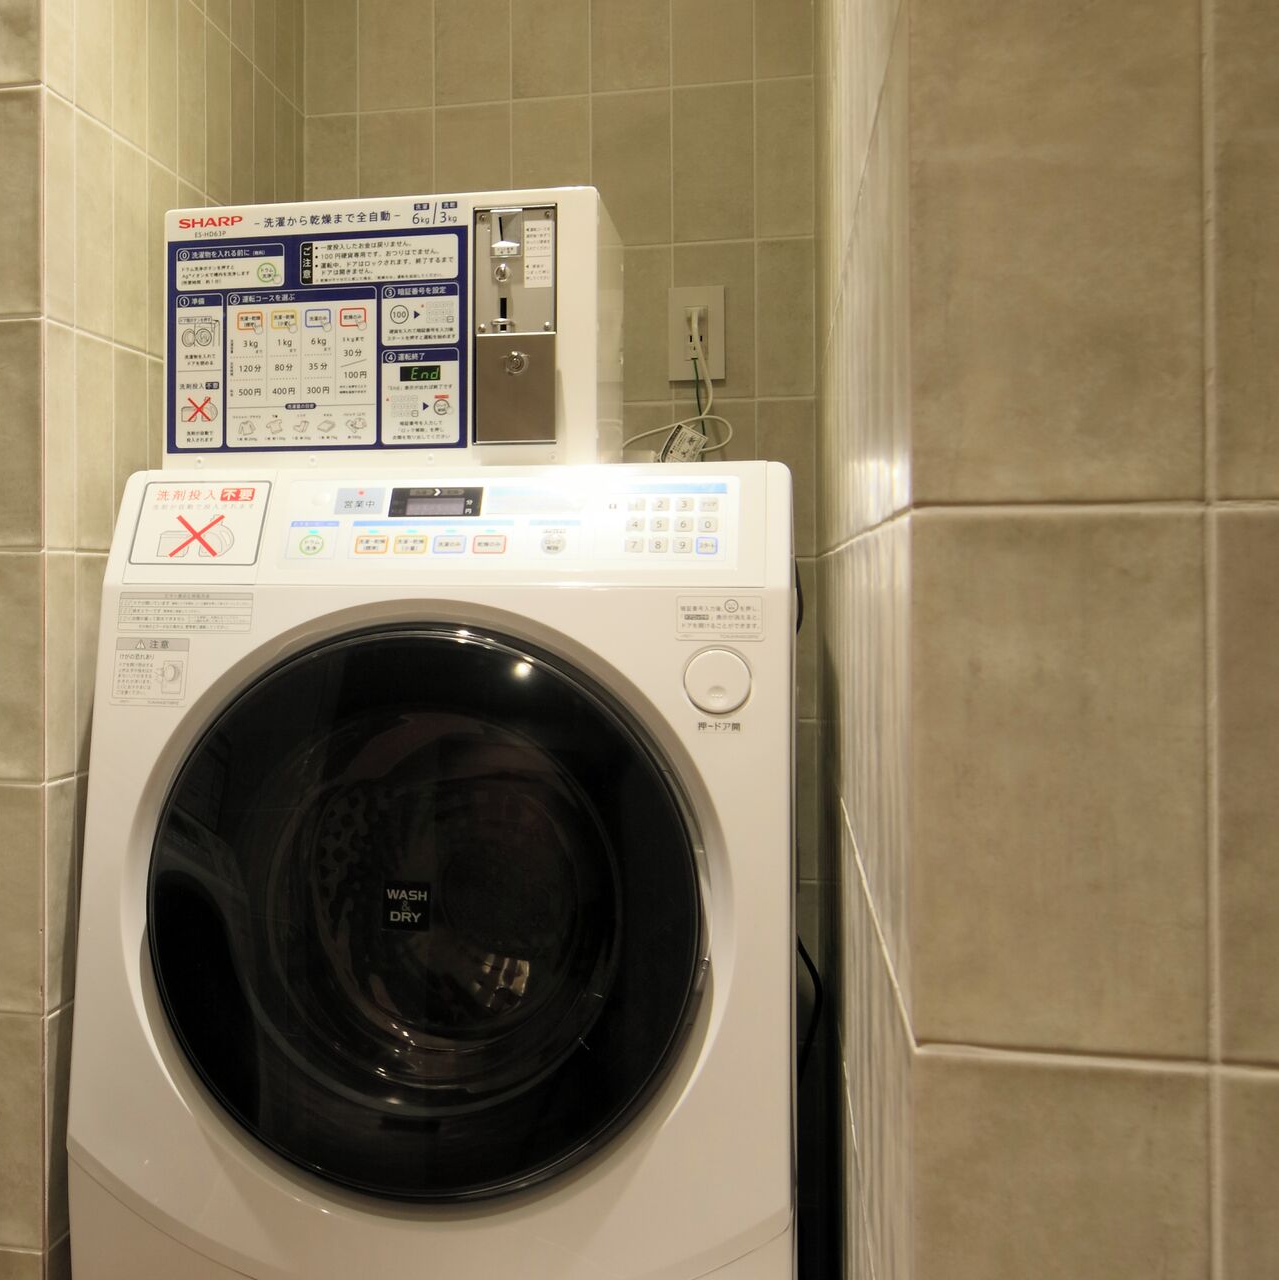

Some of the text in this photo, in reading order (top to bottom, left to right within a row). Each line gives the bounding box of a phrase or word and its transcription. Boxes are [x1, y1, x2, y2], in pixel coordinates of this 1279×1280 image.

[179, 215, 243, 229] SHARP
[412, 211, 457, 225] 6kg 3kg
[320, 241, 413, 251] 一度投入したお金は戻りません。
[191, 249, 250, 260] 洗濯物を入れる前に
[302, 247, 312, 278] ご注意
[320, 256, 454, 269] 運転中、ドアはロックされます。終了するまで
[321, 268, 374, 276] ドアは開きません。
[398, 286, 447, 295] 暗証番号を設定
[242, 293, 295, 303] 運転コースを選ぶ
[392, 310, 406, 319] 100
[243, 340, 258, 348] 3kg
[277, 339, 292, 347] 1kg
[310, 338, 327, 346] 6kg
[398, 352, 425, 361] 運転終了
[239, 364, 262, 373] 120分
[274, 363, 293, 371] 80分
[308, 363, 328, 371] 35分
[343, 371, 367, 379] 100円
[410, 367, 440, 380] End
[238, 388, 262, 396] 500円
[272, 387, 296, 395] 400円
[306, 386, 330, 394] 300円
[156, 489, 254, 502] 洗剤投入 不要
[344, 500, 375, 509] 営業中
[150, 640, 170, 648] 注意
[386, 888, 428, 901] WASH
[401, 900, 411, 912] &
[390, 911, 422, 923] DRY
